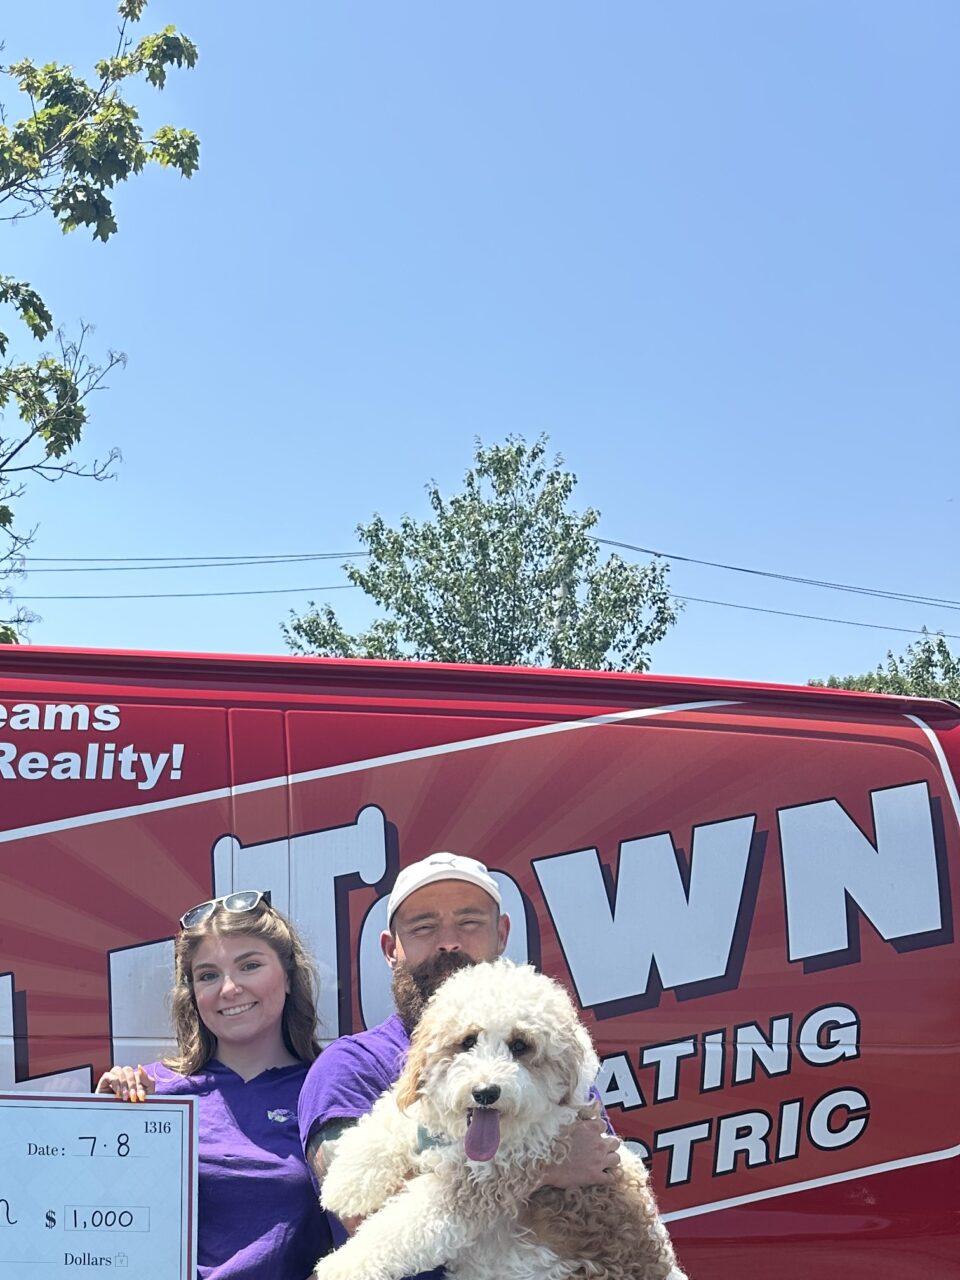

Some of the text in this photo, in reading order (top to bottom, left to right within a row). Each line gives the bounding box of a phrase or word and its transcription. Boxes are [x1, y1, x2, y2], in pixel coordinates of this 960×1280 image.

[144, 1121, 171, 1134] 1316
[620, 1086, 871, 1188] TRIC
[45, 1209, 57, 1229] $
[73, 1209, 134, 1230] 1,000
[64, 1252, 112, 1267] Dollars
